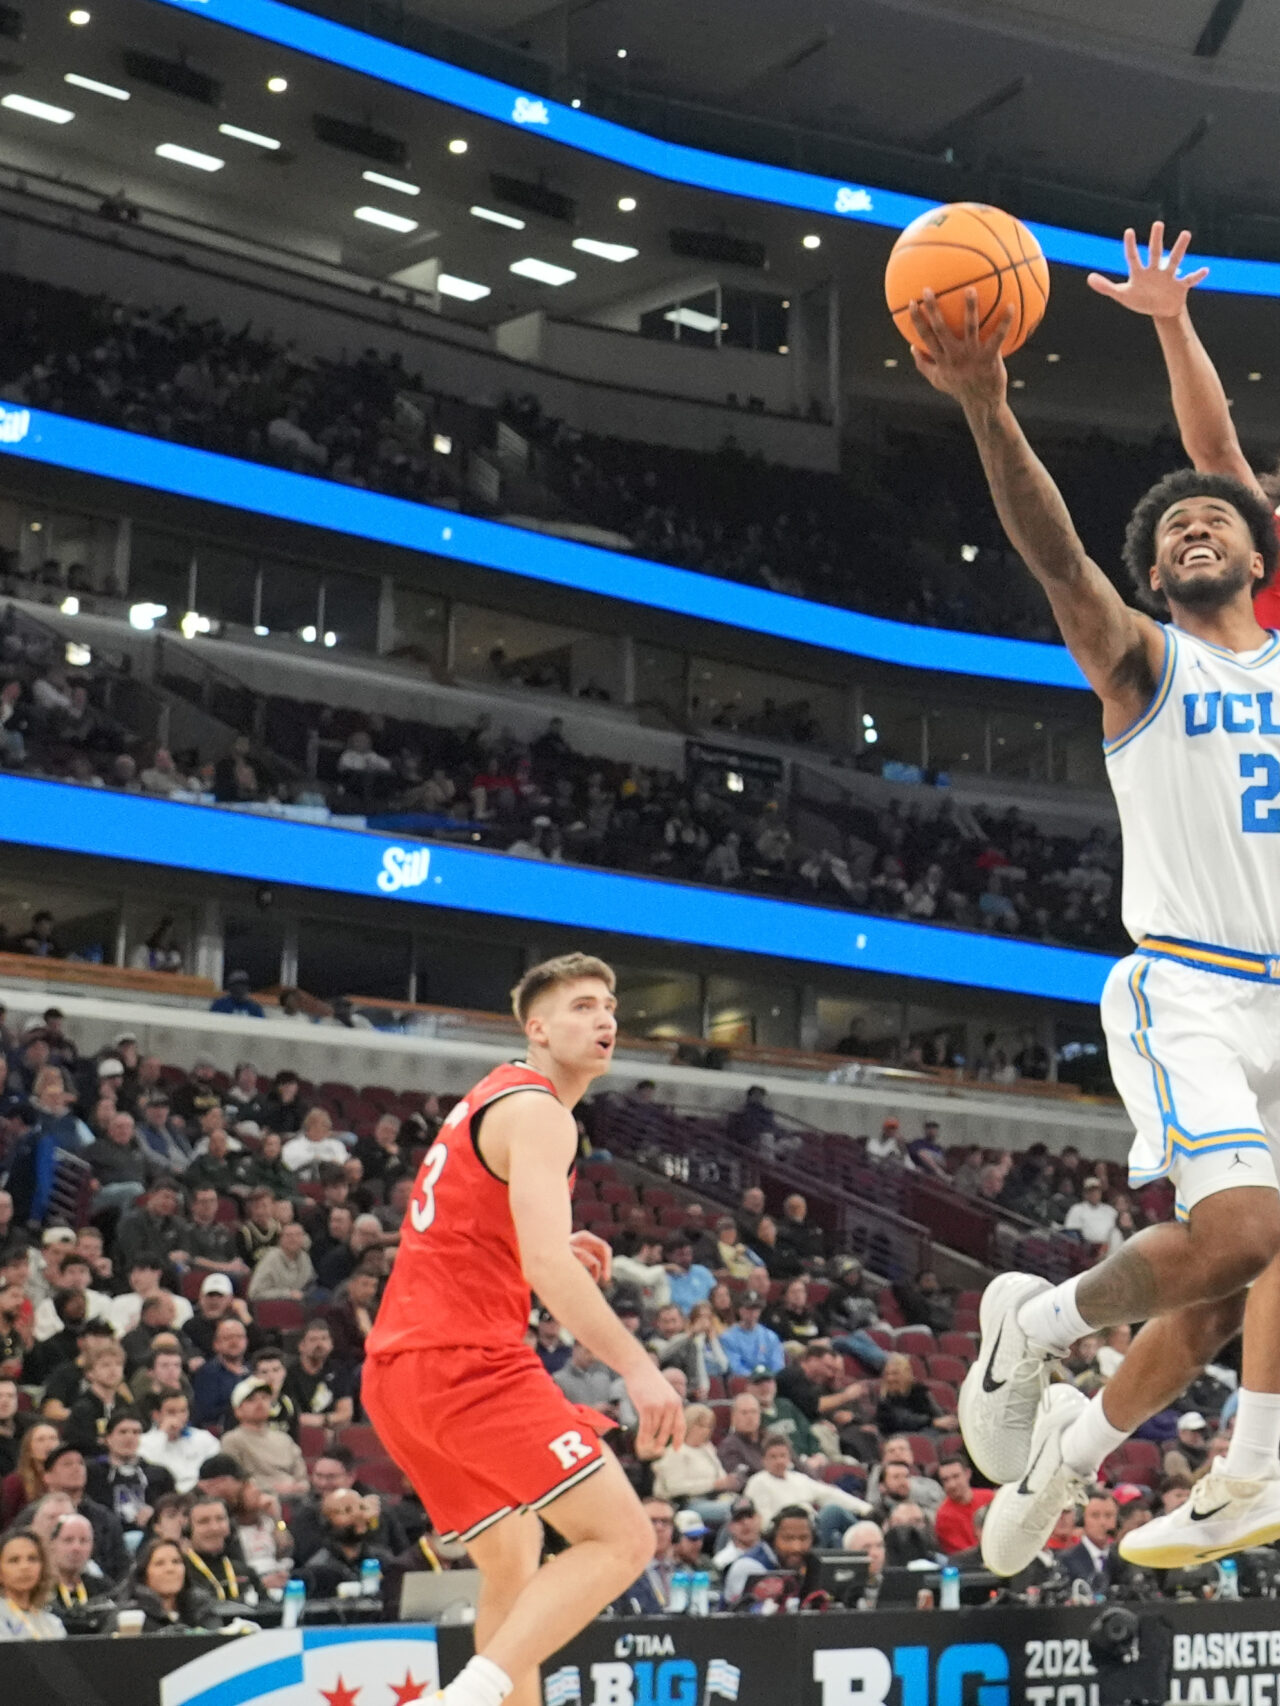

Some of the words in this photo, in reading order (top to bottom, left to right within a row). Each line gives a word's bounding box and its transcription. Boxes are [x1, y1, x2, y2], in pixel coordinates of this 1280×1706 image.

[411, 1142, 448, 1233] 3
[548, 1429, 594, 1471] R
[636, 1633, 676, 1657] TIAA
